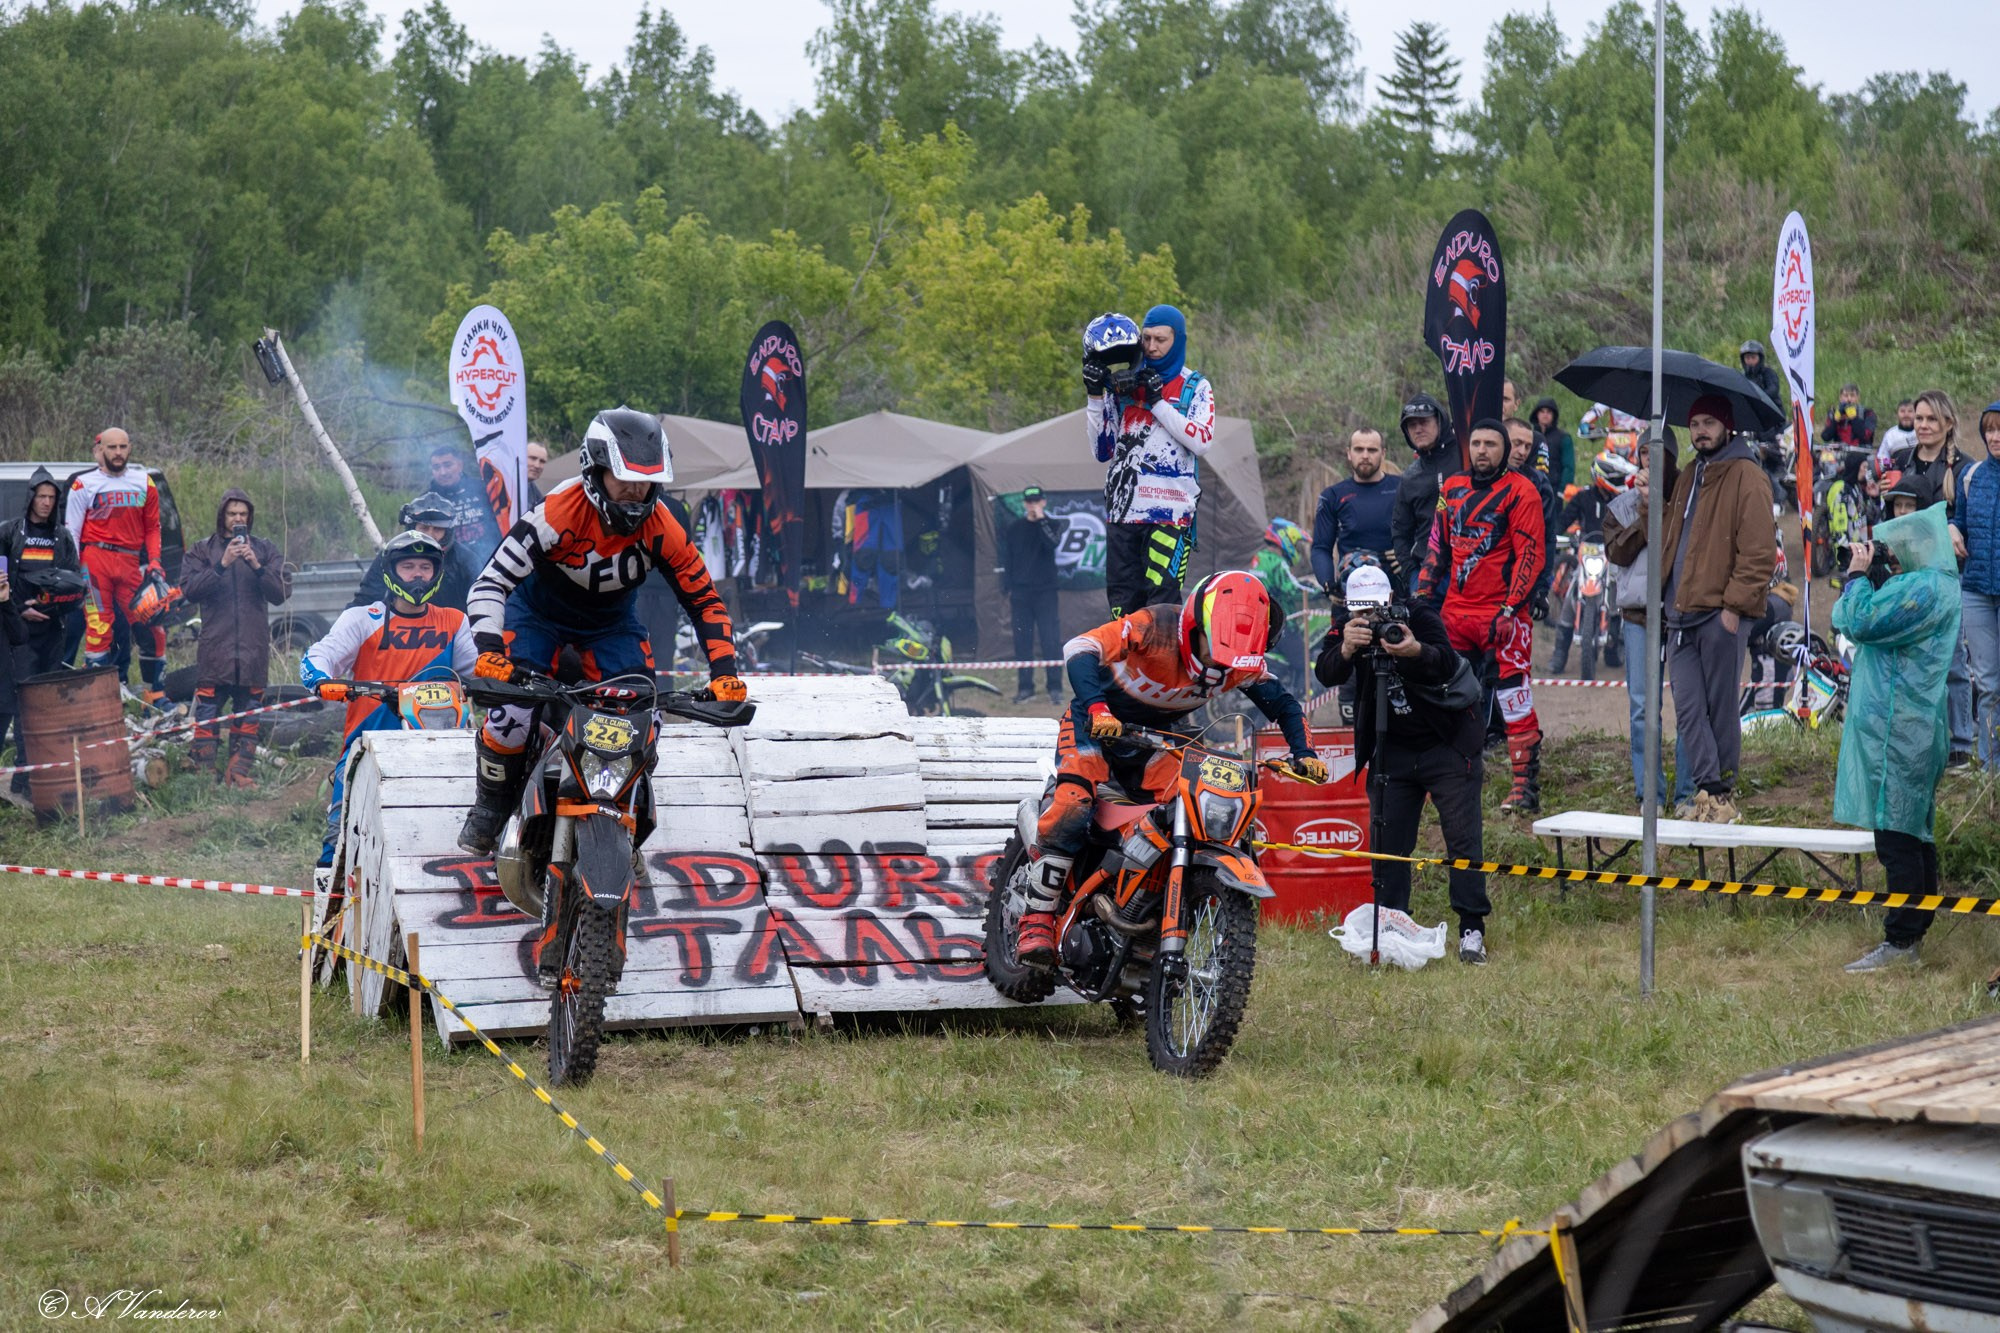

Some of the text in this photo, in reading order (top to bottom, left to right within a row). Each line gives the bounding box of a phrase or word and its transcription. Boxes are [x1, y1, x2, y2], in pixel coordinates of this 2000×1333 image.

[1434, 230, 1500, 288] ENDURO
[1778, 289, 1811, 310] HYPERCUT
[461, 319, 508, 368] СТАНКИ ЧПУ
[750, 335, 802, 376] ENDURO
[456, 368, 517, 384] HYPERCUT
[98, 491, 140, 506] LEATT
[588, 534, 665, 594] FOX
[1168, 534, 1185, 578] LEATT
[387, 626, 449, 650] KTM
[1232, 655, 1264, 668] LEATT
[426, 690, 440, 699] 11
[594, 716, 629, 728] HILL CLIMB
[595, 725, 619, 744] 24
[1209, 757, 1223, 766] HILL
[1211, 766, 1232, 784] 64
[1296, 829, 1360, 845] SINTEC
[423, 837, 1010, 931] EDUR
[541, 874, 551, 928] CHAMP
